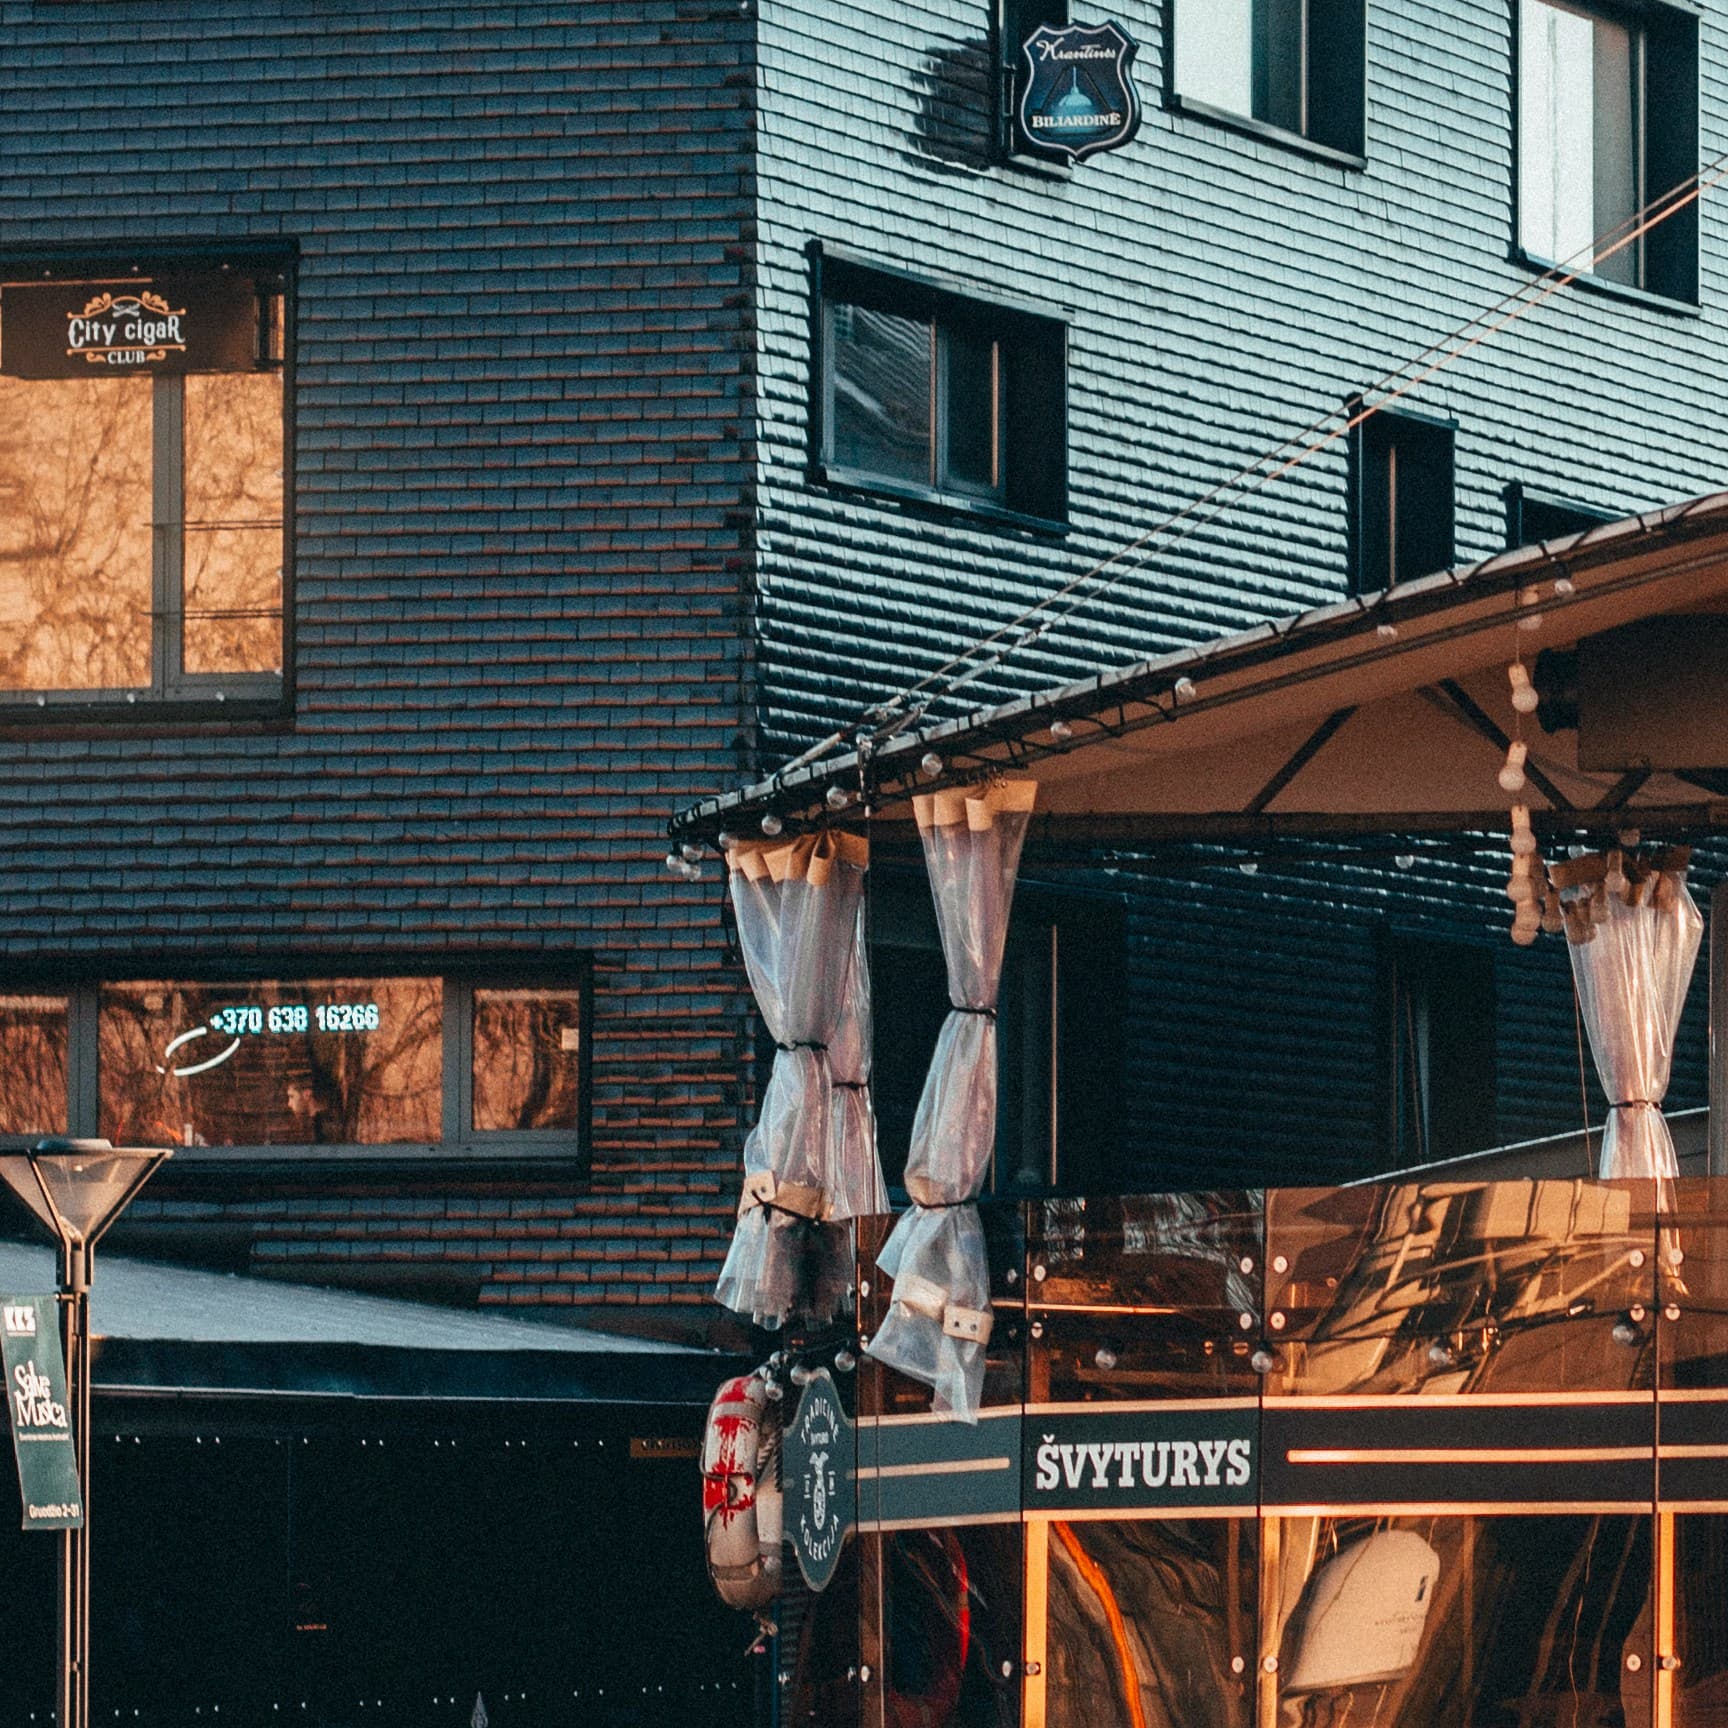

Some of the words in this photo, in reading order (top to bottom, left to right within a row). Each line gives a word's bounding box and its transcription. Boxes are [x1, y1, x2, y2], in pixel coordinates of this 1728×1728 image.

[68, 318, 116, 348] City
[107, 350, 145, 364] CLUB
[210, 1006, 263, 1034] +370
[268, 1005, 308, 1033] 638
[315, 1003, 379, 1031] 16266
[1034, 1434, 1251, 1490] ŠVYTURYS
